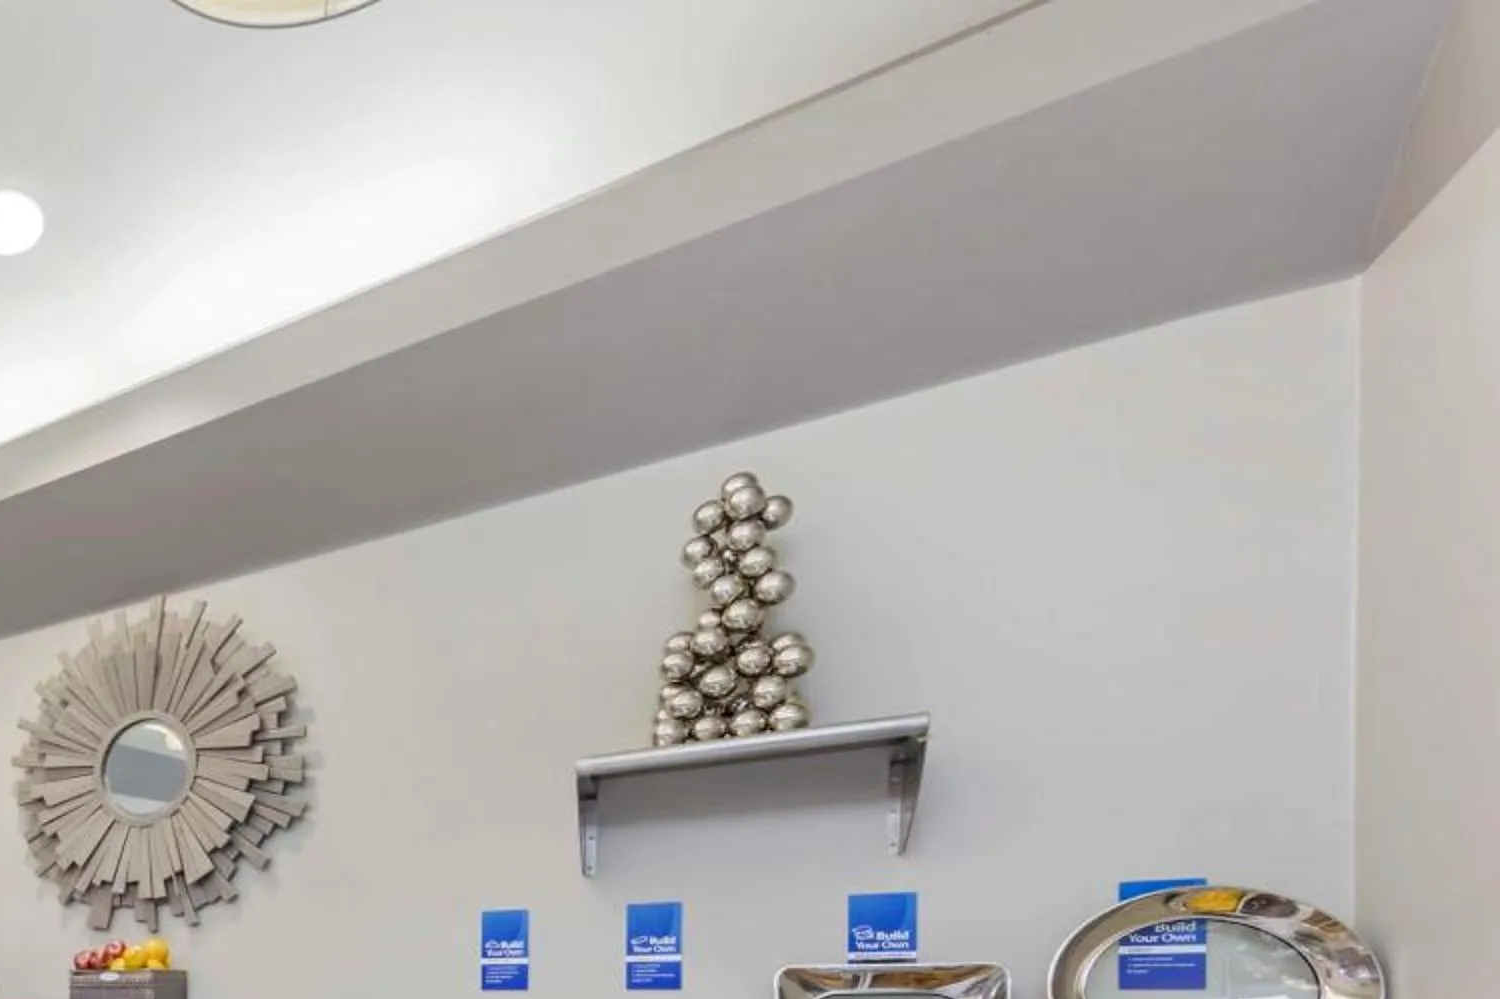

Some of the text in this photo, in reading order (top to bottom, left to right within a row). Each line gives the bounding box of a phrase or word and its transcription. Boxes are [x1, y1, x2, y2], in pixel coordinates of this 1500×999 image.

[1155, 921, 1196, 933] Build
[649, 935, 676, 945] Build
[876, 930, 909, 941] Build
[1130, 932, 1196, 943] Your Own
[501, 940, 524, 949] Build
[856, 941, 909, 950] Your Own
